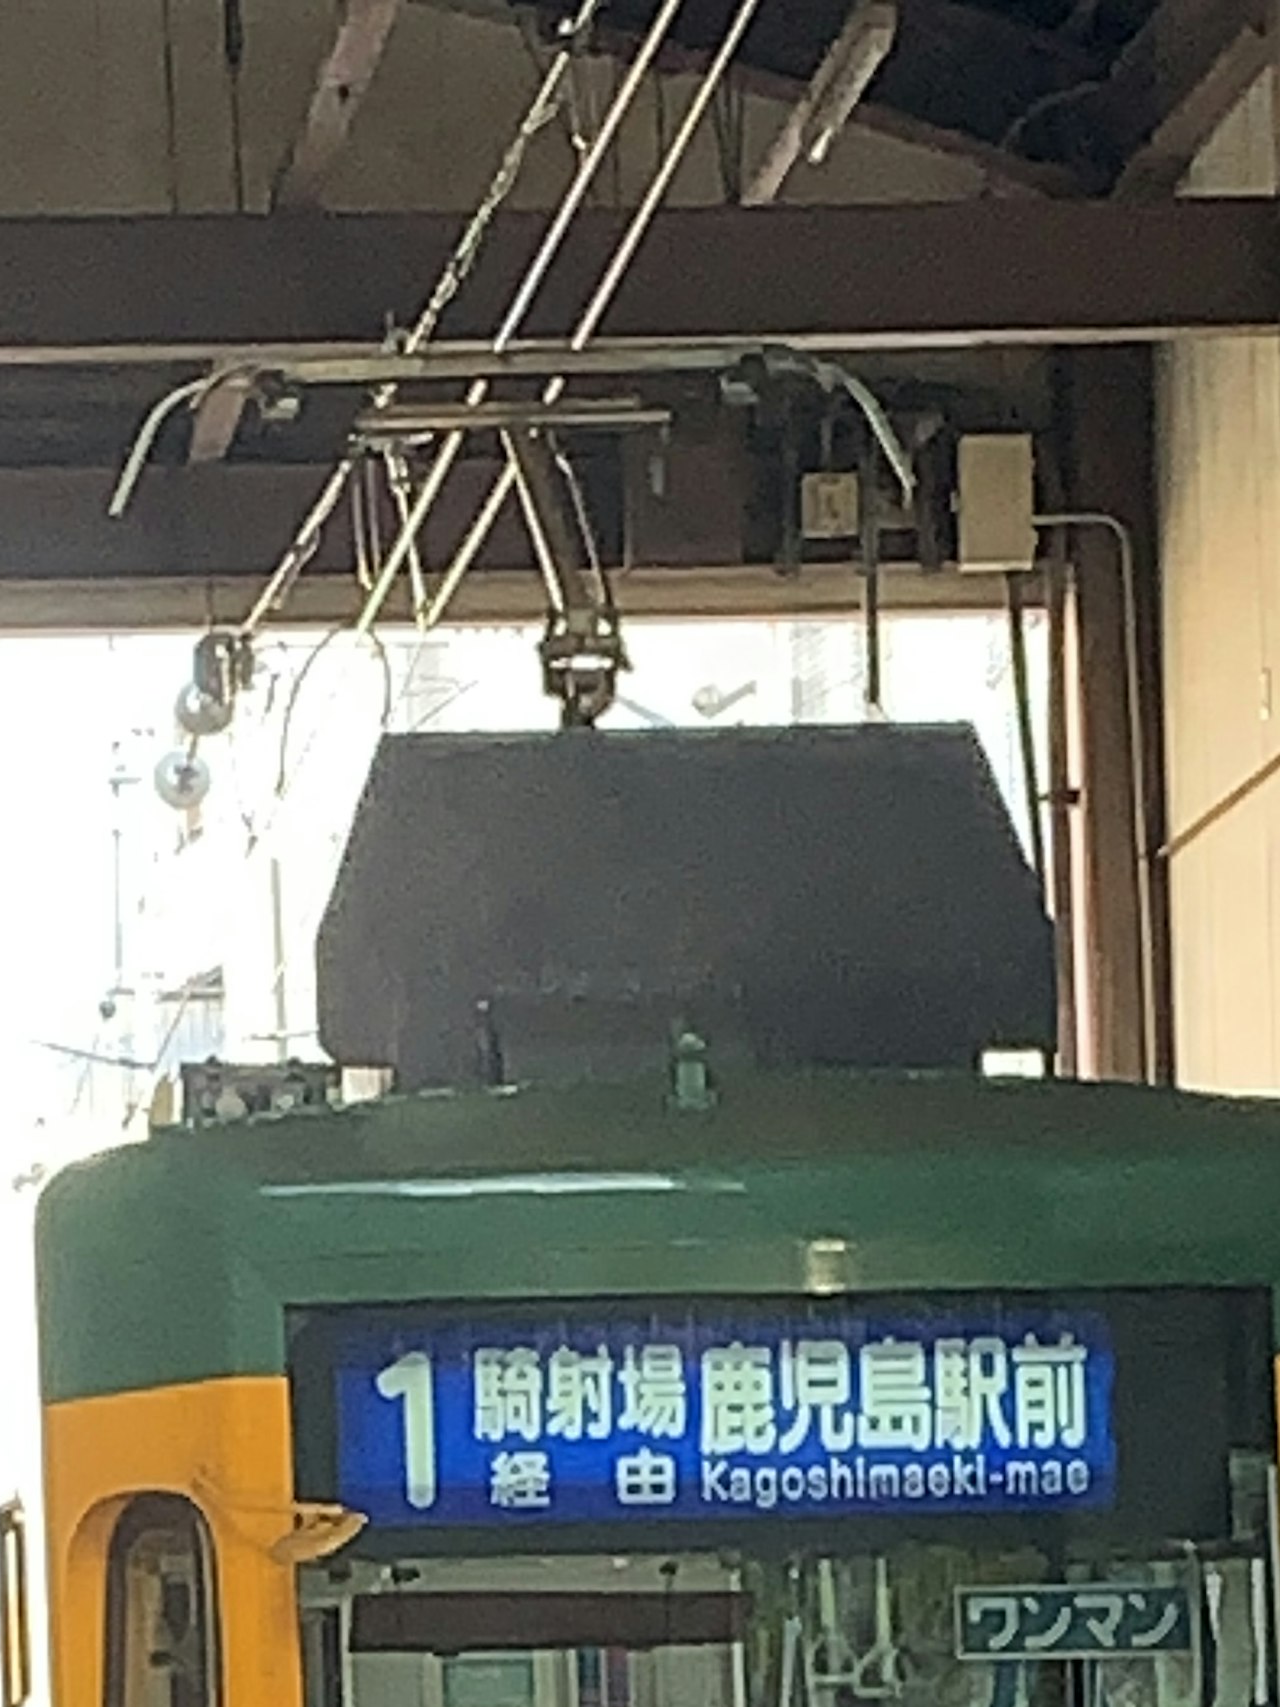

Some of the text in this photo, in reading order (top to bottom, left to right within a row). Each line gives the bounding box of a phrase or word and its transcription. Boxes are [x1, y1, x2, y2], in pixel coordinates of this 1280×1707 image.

[375, 1350, 436, 1509] 1
[473, 1332, 1088, 1455] 騎射場 鹿児島駅前
[700, 1454, 1090, 1509] Kagoshimaeki-mae
[965, 1594, 1183, 1651] ワンマン
